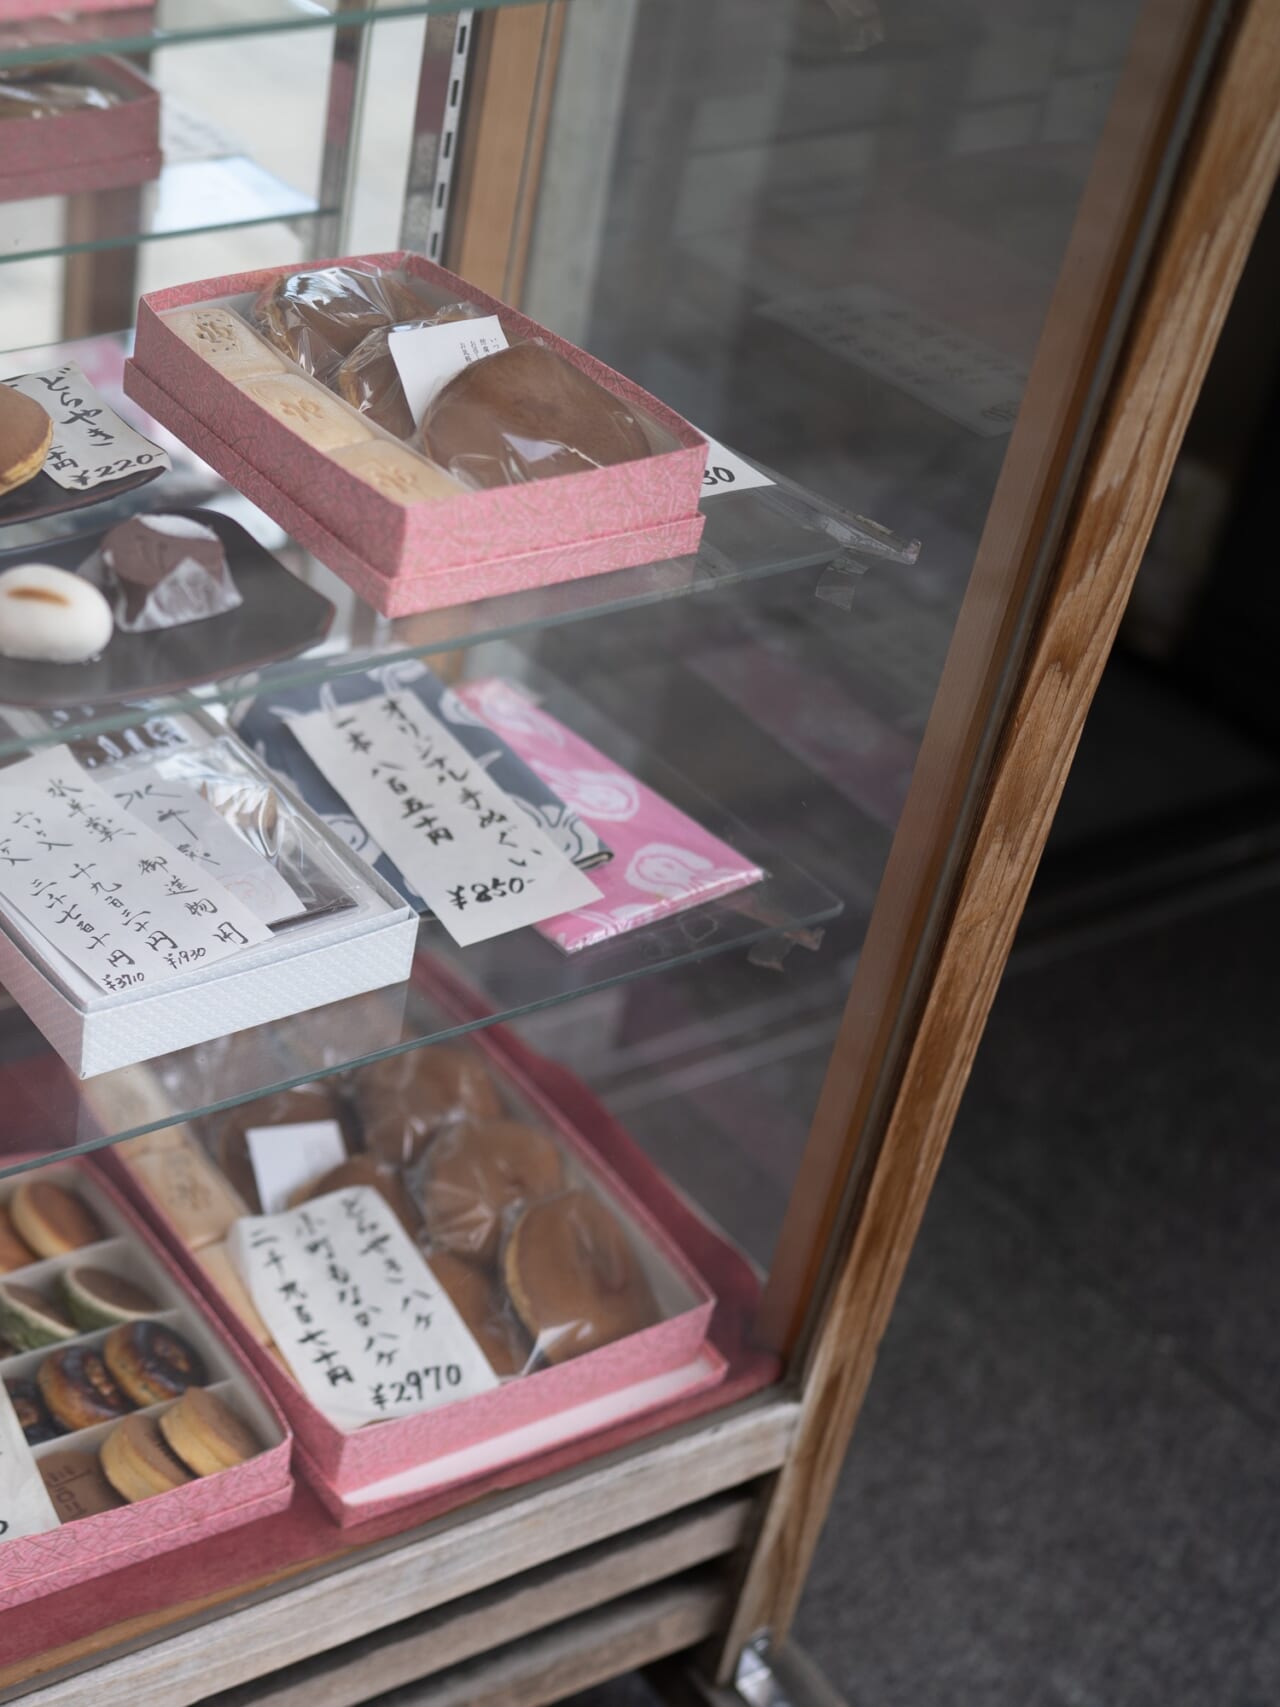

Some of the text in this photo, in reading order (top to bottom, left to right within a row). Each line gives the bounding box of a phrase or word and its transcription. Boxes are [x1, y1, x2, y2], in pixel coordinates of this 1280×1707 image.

[36, 367, 114, 446] どらやき
[163, 946, 207, 971] ¥1930
[101, 970, 146, 993] ¥3710
[371, 1363, 463, 1411] ¥2970
